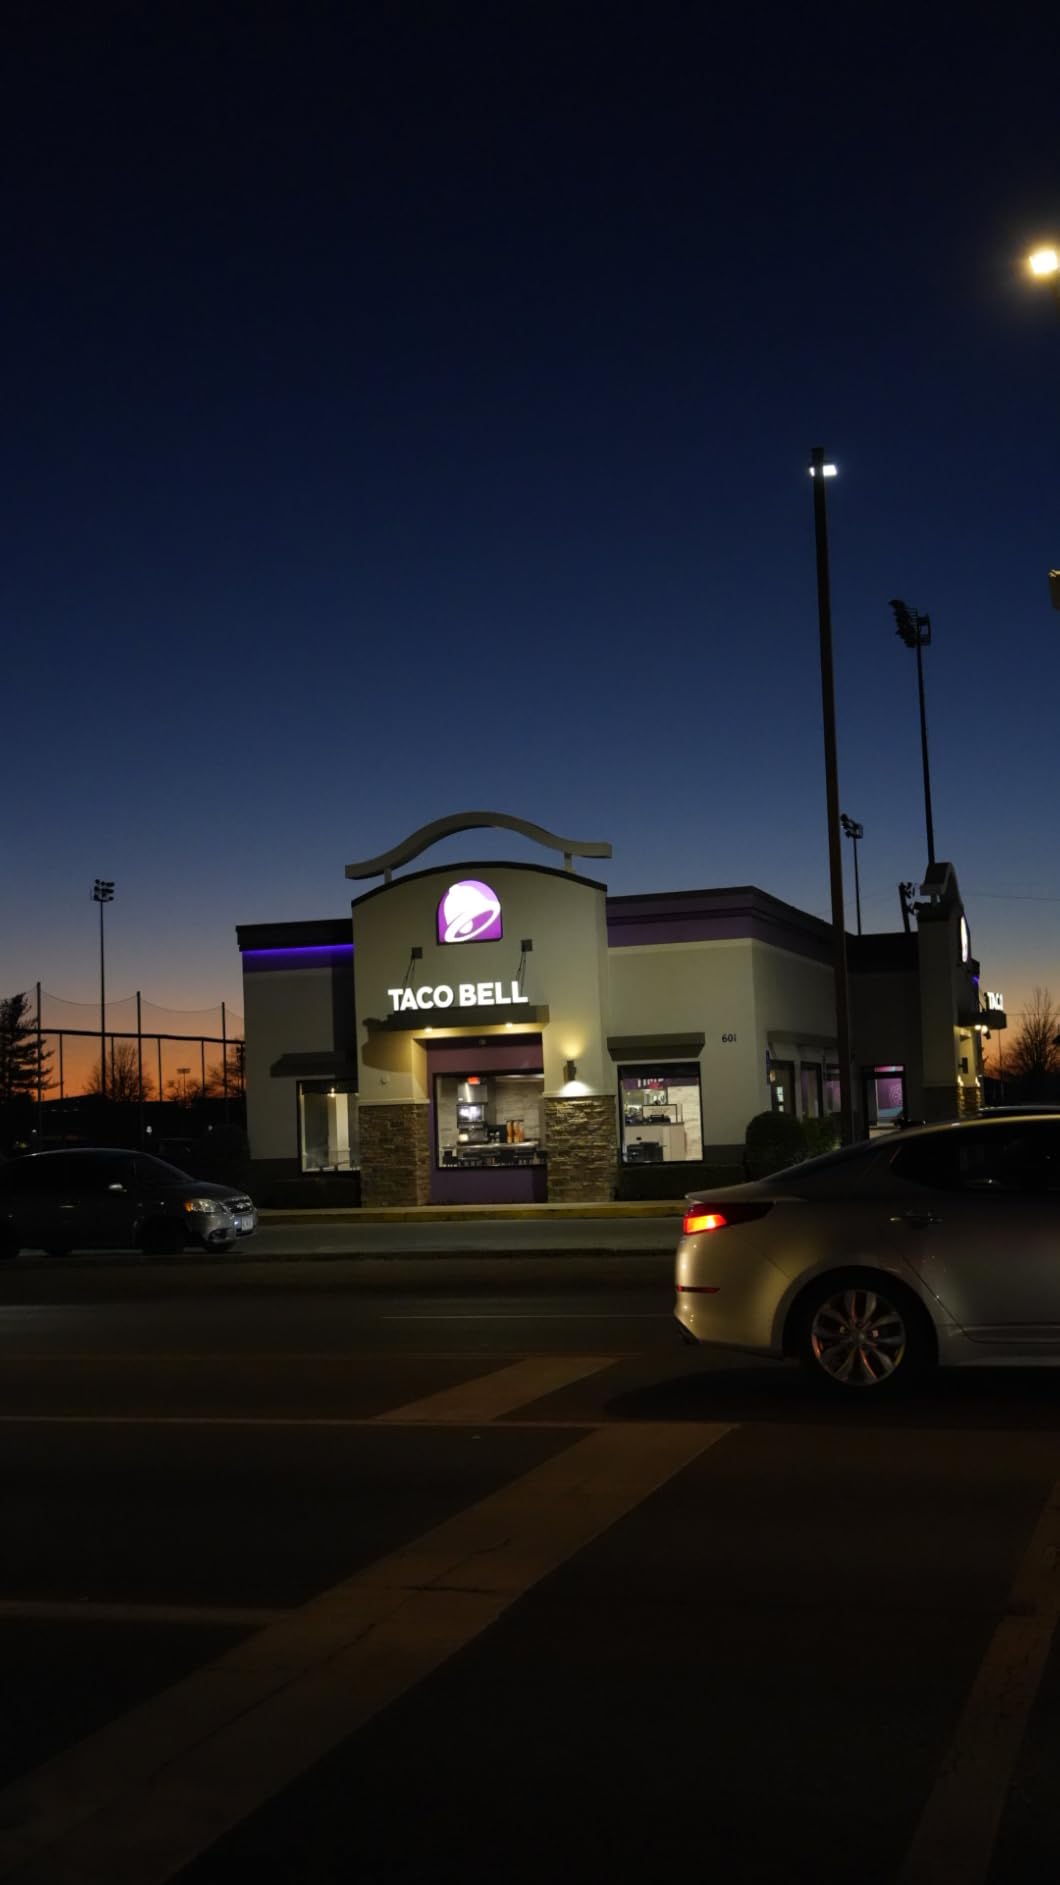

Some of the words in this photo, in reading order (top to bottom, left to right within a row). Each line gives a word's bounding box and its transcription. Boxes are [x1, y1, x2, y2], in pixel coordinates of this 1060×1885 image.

[388, 985, 454, 1011] TACO
[459, 981, 529, 1007] BELL
[721, 1033, 737, 1043] 601
